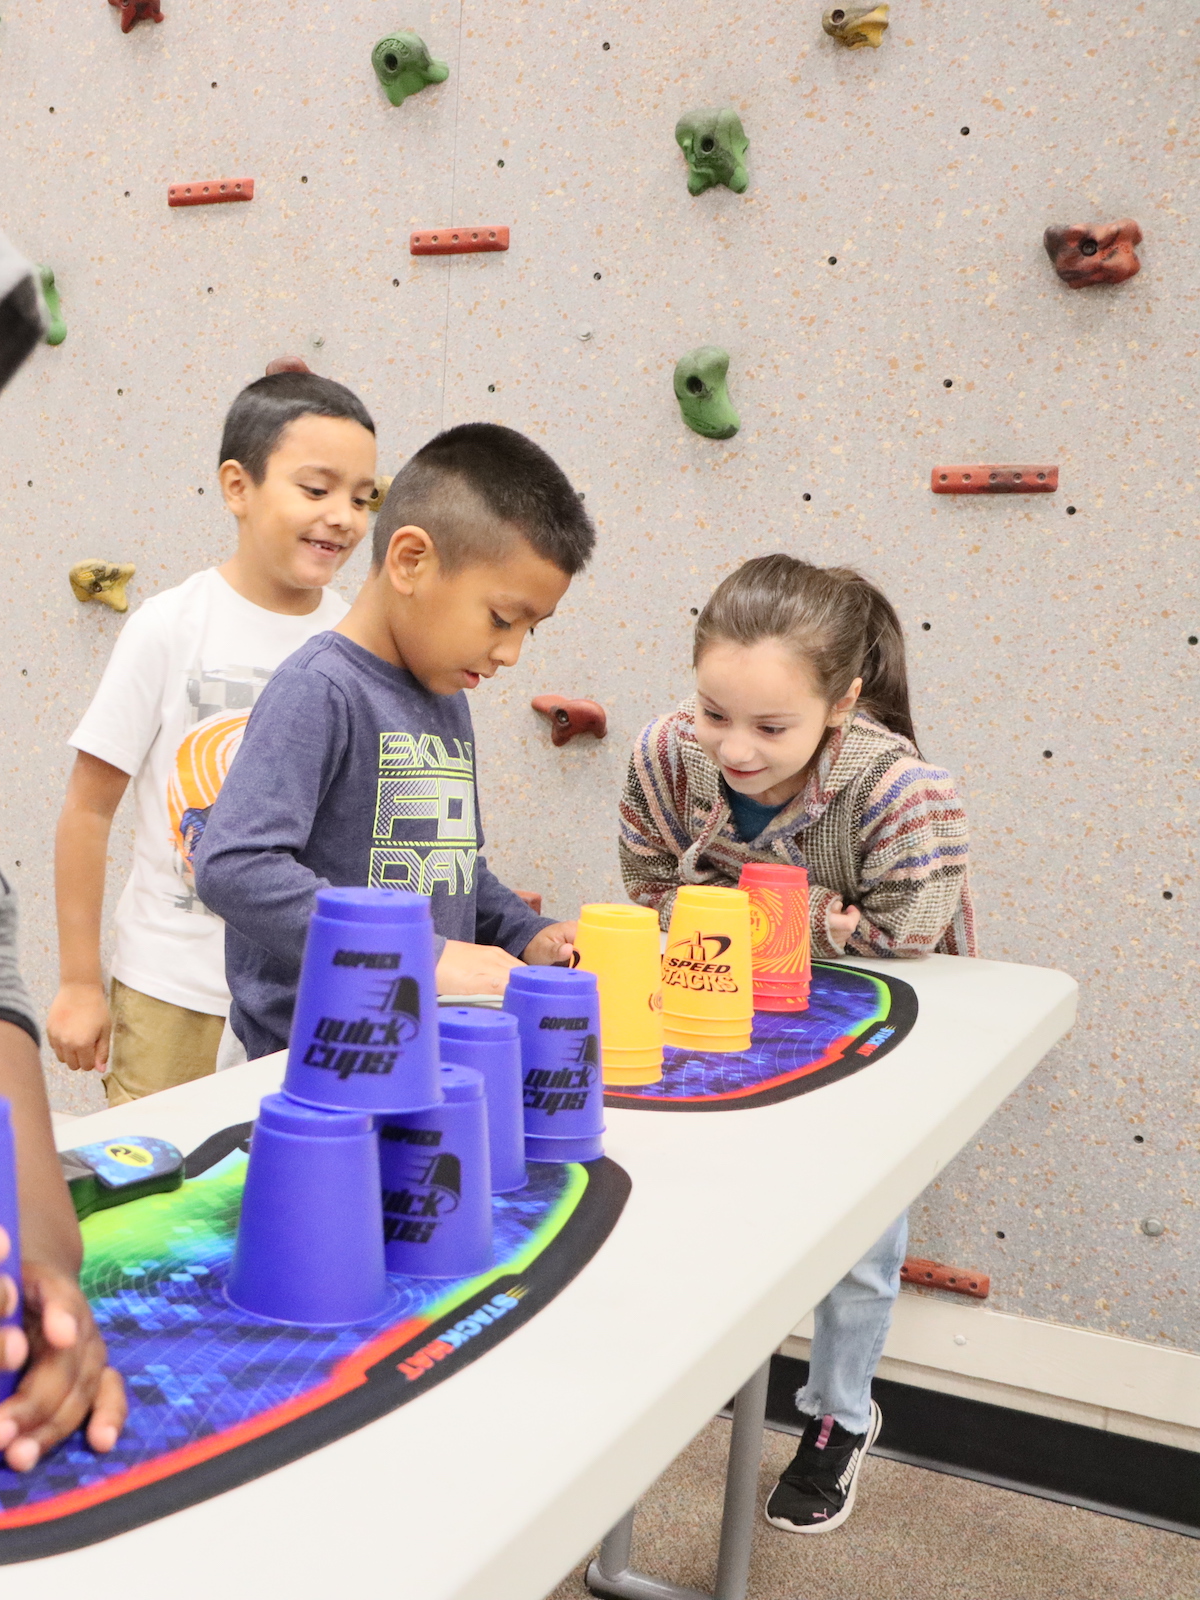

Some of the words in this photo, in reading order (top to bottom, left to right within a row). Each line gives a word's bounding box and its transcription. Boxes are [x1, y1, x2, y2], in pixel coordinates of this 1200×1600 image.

[668, 957, 731, 974] SPEED
[539, 1016, 589, 1031] GOPHER
[382, 1189, 444, 1217] uick
[396, 1293, 519, 1381] STACKMAT
